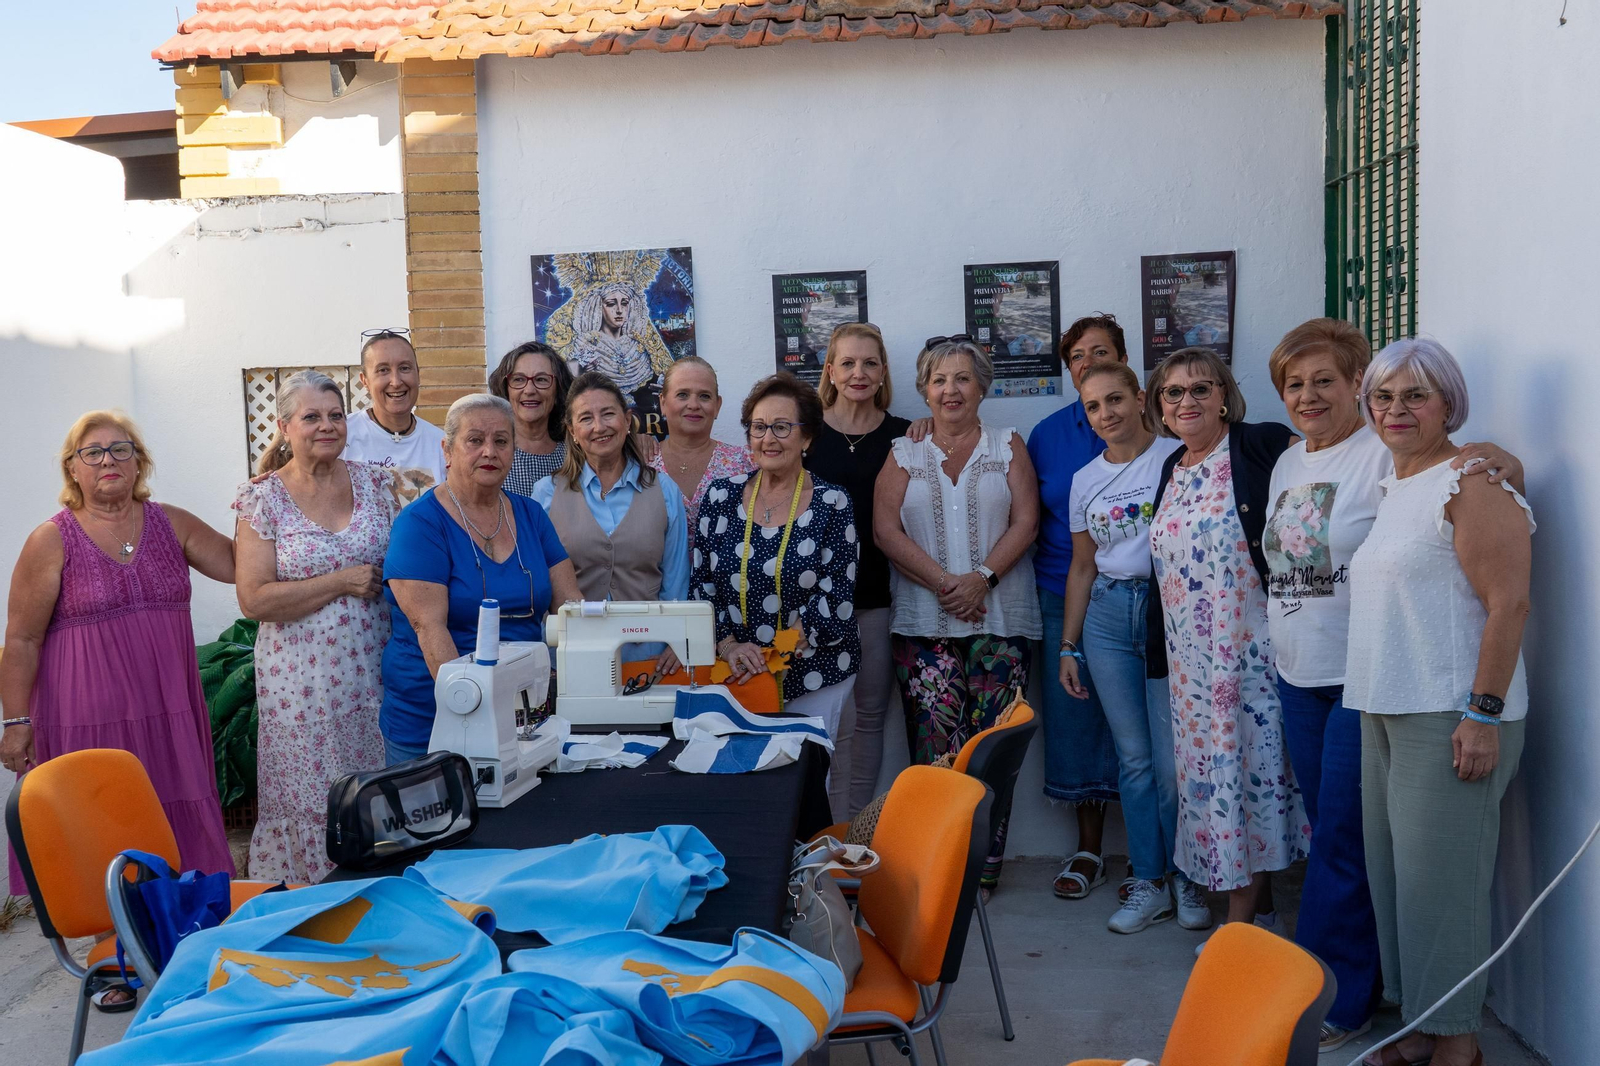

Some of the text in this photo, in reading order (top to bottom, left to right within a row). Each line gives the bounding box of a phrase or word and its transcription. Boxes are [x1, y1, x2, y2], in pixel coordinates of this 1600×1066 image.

[980, 267, 1019, 276] CONCURSO
[787, 277, 827, 286] CONCURSO
[975, 276, 991, 284] ARTE
[1150, 278, 1187, 286] PRIMAVERA
[973, 287, 1011, 295] PRIMAVERA
[1152, 335, 1167, 343] 600
[784, 354, 806, 362] 600 €
[382, 798, 453, 833] WASHBA
